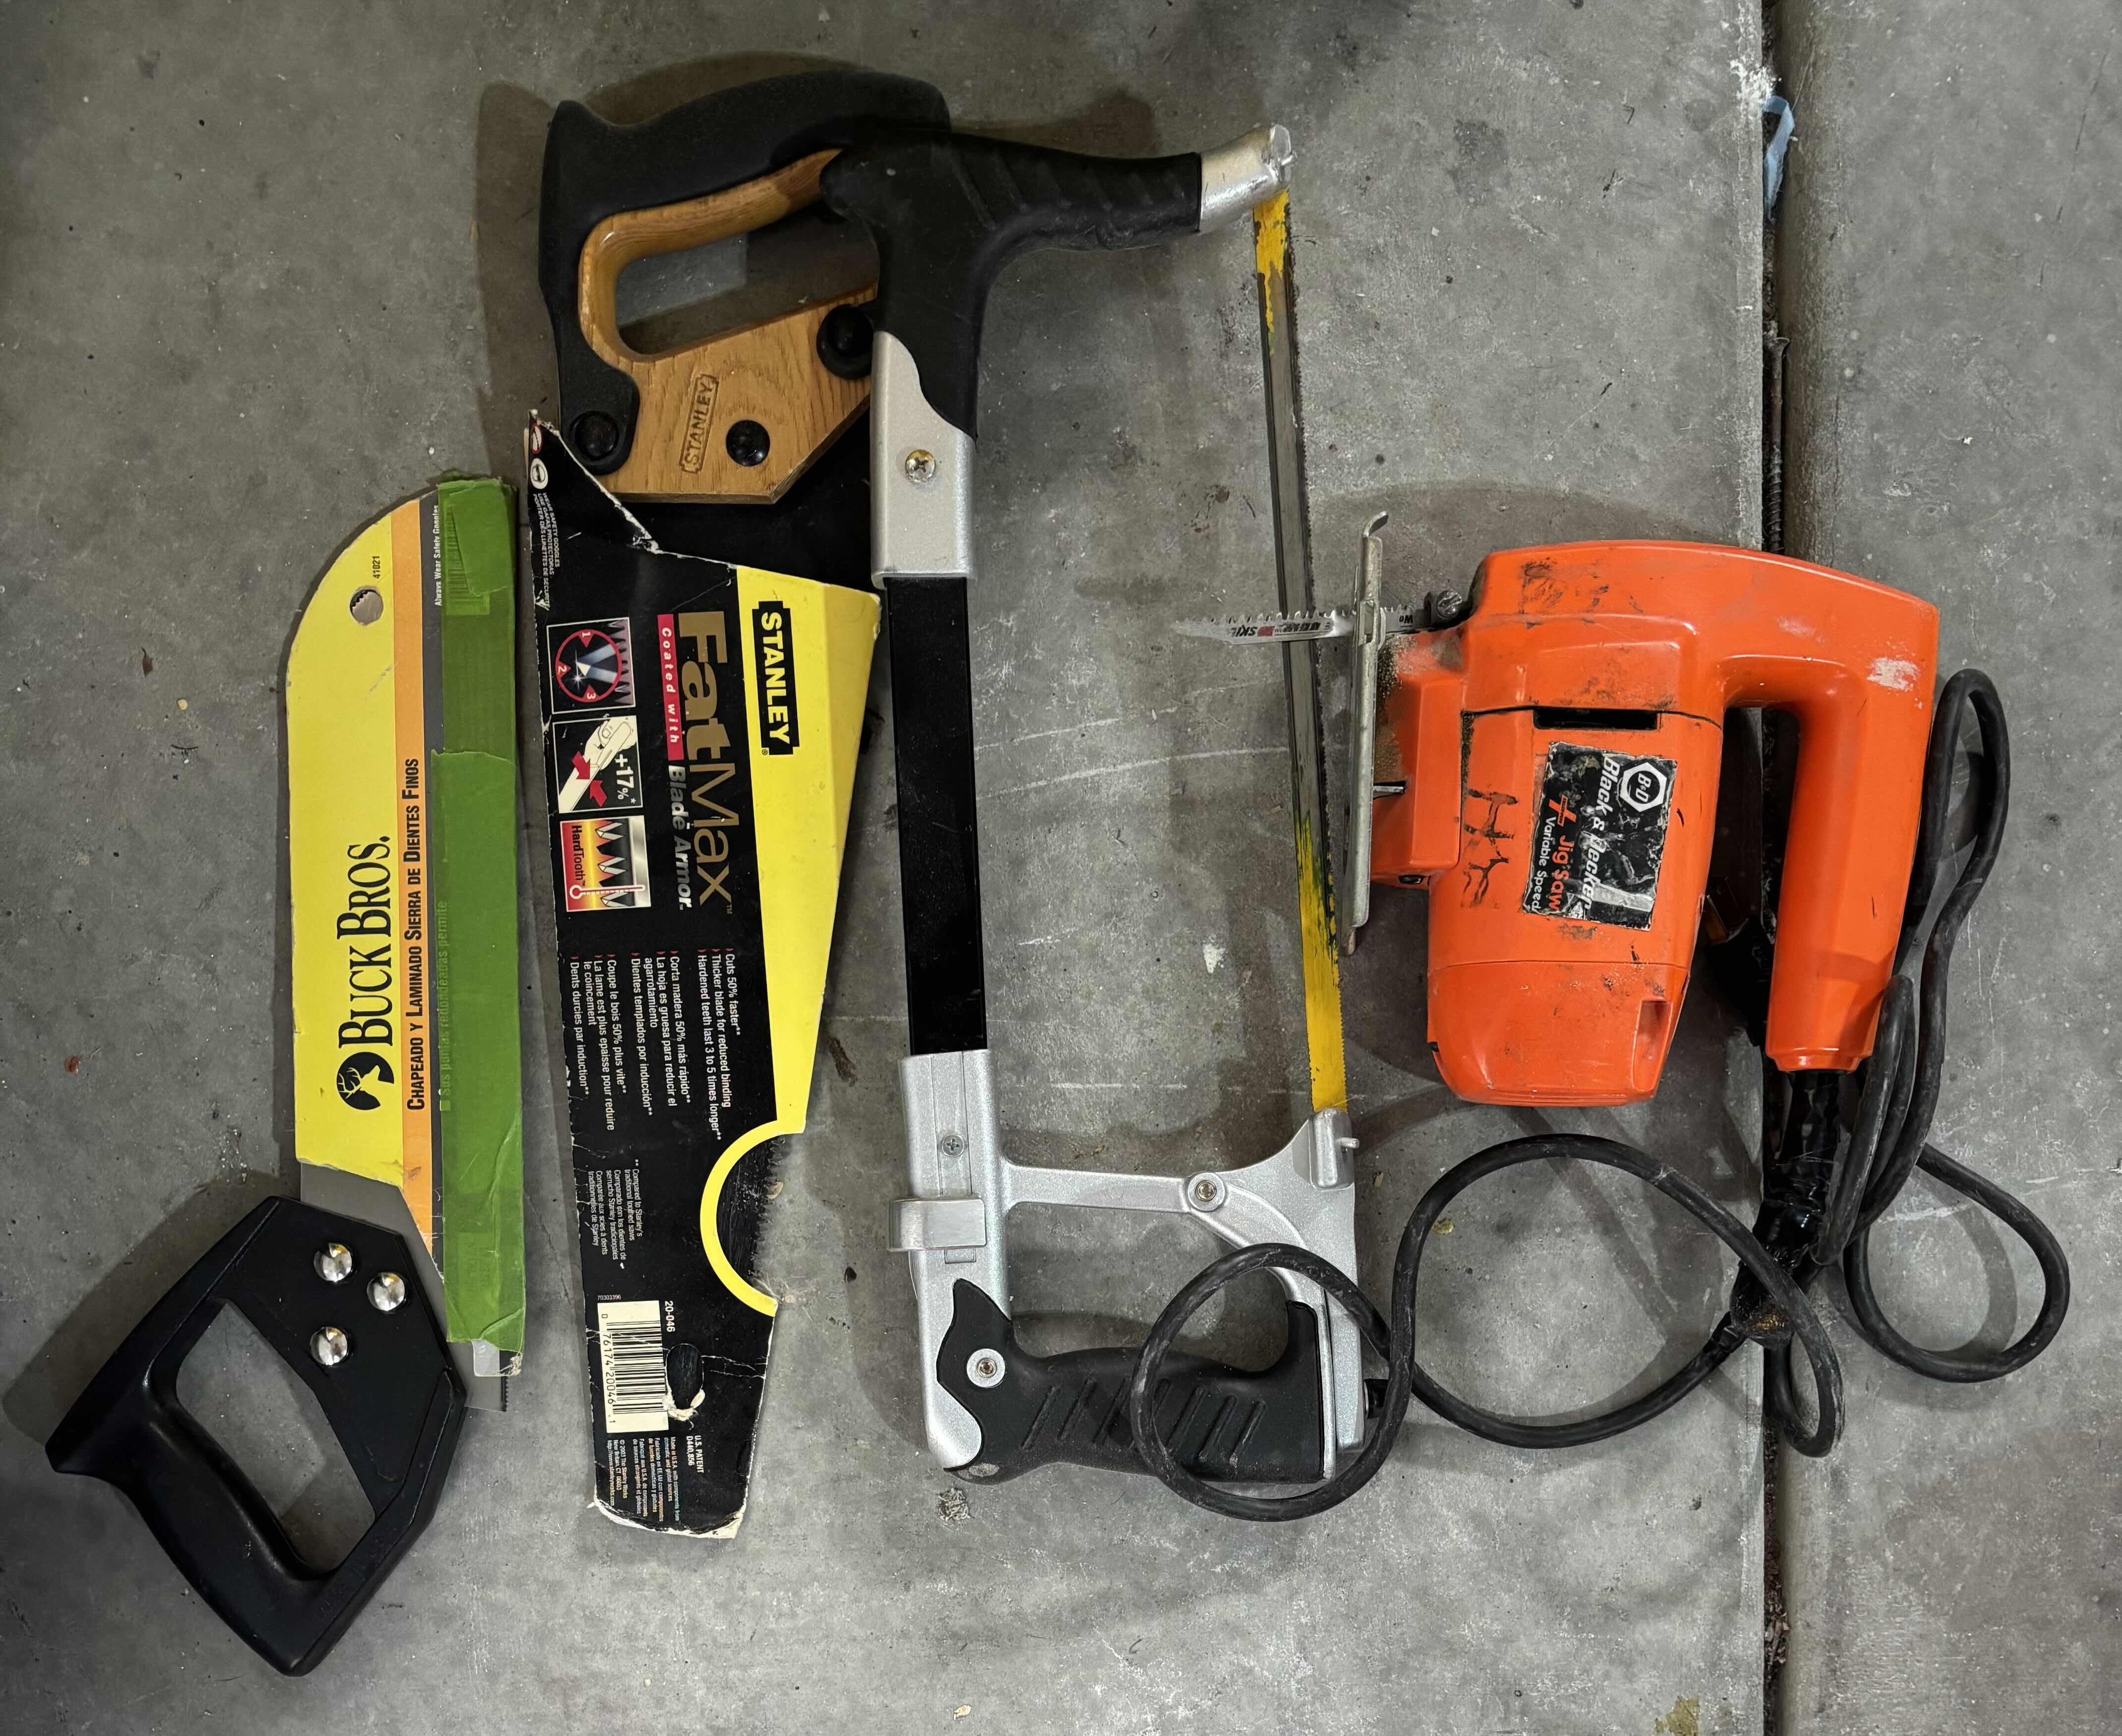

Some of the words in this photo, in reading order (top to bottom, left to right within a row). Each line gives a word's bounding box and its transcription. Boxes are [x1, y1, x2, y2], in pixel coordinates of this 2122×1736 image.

[684, 382, 712, 465] STANLEY
[542, 493, 553, 511] WEAR
[549, 513, 558, 536] SAFETY
[542, 507, 551, 528] GAFAS
[532, 494, 544, 520] PORTER
[542, 567, 548, 576] DE
[661, 627, 676, 693] Coated
[667, 704, 679, 743] with
[402, 759, 419, 799] FINOS
[1596, 757, 1620, 816] Black
[667, 765, 690, 830] Blade
[403, 805, 420, 862] DIENTES
[1592, 817, 1605, 832] &
[1539, 816, 1556, 867] Variable
[1552, 835, 1575, 865] Jig
[1531, 870, 1548, 909] Speed
[1548, 869, 1569, 911] Saw
[404, 891, 421, 940] SIERRA
[570, 962, 581, 988] Dents
[584, 961, 592, 969] le
[593, 960, 603, 972] La
[607, 959, 617, 988] Coupe
[631, 958, 642, 993] Dientes
[656, 957, 666, 968] La
[670, 956, 680, 981] Corta
[698, 955, 710, 999] Hardened
[711, 954, 722, 989] Thicker
[725, 954, 736, 974] Cuts
[338, 943, 393, 1048] BUCK
[406, 946, 423, 1017] LAMINADO
[595, 974, 604, 997] lame
[610, 991, 619, 1000] le
[643, 958, 659, 1028] agarrotamiento
[656, 971, 668, 991] hoja
[727, 977, 738, 998] 50%
[572, 991, 583, 1024] durcies
[584, 972, 597, 1025] coincement
[596, 999, 606, 1014] est
[610, 1002, 621, 1021] bois
[659, 993, 667, 1004] es
[672, 984, 683, 1018] madera
[701, 1002, 712, 1025] teeth
[714, 991, 725, 1017] blade
[596, 1016, 608, 1035] plus
[612, 1023, 623, 1044] 50%
[634, 995, 647, 1043] templados
[658, 1006, 670, 1038] gruesa
[675, 1021, 686, 1042] 50%
[717, 1019, 726, 1032] for
[574, 1027, 584, 1042] par
[704, 1028, 714, 1045] last
[598, 1037, 610, 1073] epaisse
[612, 1047, 624, 1066] plus
[636, 1046, 647, 1061] por
[661, 1040, 672, 1061] para
[677, 1044, 688, 1064] más
[706, 1055, 715, 1065] to
[718, 1034, 730, 1071] reduced
[407, 1037, 424, 1110] CHAPEADO
[601, 1075, 611, 1096] pour
[665, 1063, 677, 1096] reducir
[707, 1076, 717, 1101] times
[667, 1098, 677, 1106] el
[721, 1074, 732, 1107] binding
[605, 1098, 616, 1131] reduire
[606, 1170, 614, 1197] serrucho
[614, 1170, 623, 1205] Comparado
[624, 1169, 633, 1199] traditional
[631, 1169, 642, 1200] Compared
[608, 1198, 616, 1220] Stanley
[633, 1209, 643, 1237] Stanley's
[590, 1223, 600, 1246] Stanley
[664, 1301, 675, 1332] 20-046
[602, 1333, 613, 1366] 76174
[605, 1372, 616, 1404] 20046
[686, 1436, 695, 1466] D440,856
[695, 1449, 704, 1473] PATENT
